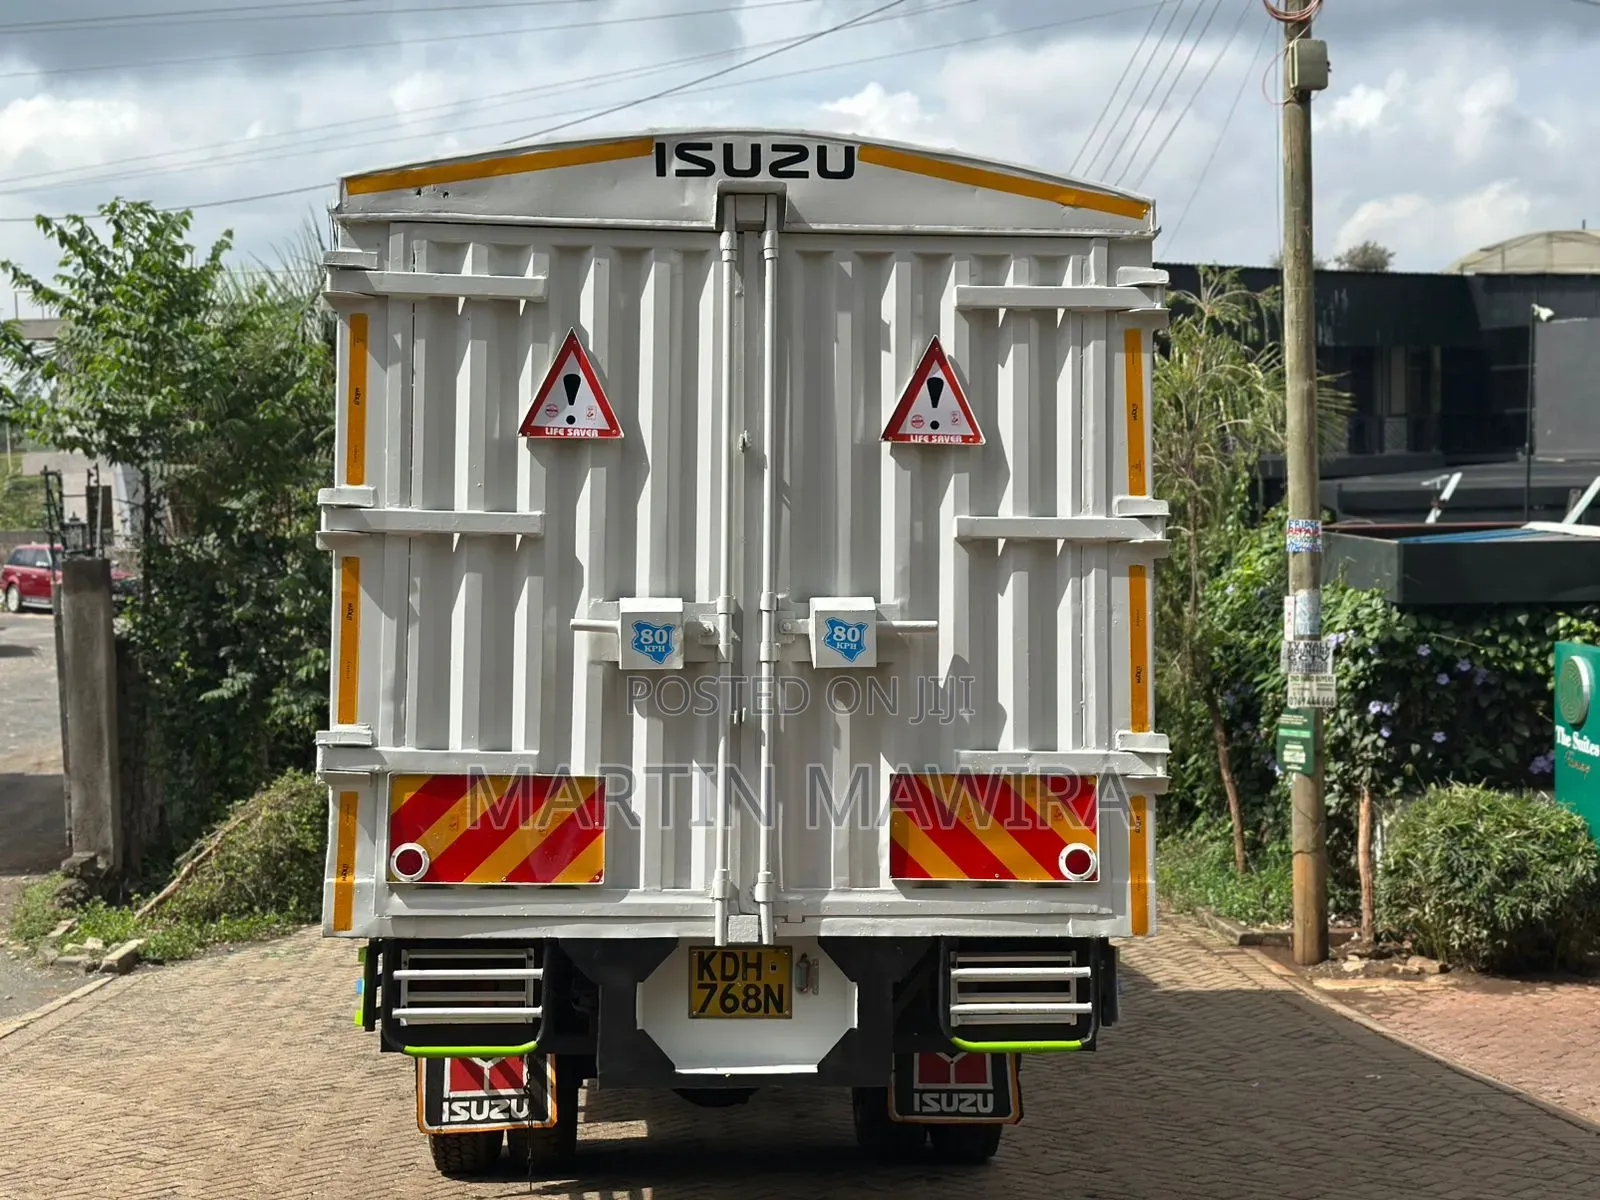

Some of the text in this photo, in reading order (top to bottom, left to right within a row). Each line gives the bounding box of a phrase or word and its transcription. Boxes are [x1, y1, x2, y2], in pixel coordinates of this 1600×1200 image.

[655, 142, 855, 179] ISUZU
[545, 427, 599, 437] LIFE SAVER
[910, 434, 962, 443] LIFE SAVER
[640, 627, 669, 645] 80
[832, 625, 861, 642] 80
[644, 645, 666, 653] KPH
[836, 641, 857, 650] KPH
[1288, 641, 1331, 650] TV WALL
[1555, 724, 1600, 757] The Suites
[697, 951, 763, 982] KDH
[697, 983, 784, 1014] 768N
[442, 1098, 530, 1123] ISUZU
[913, 1092, 994, 1114] ISUZU
